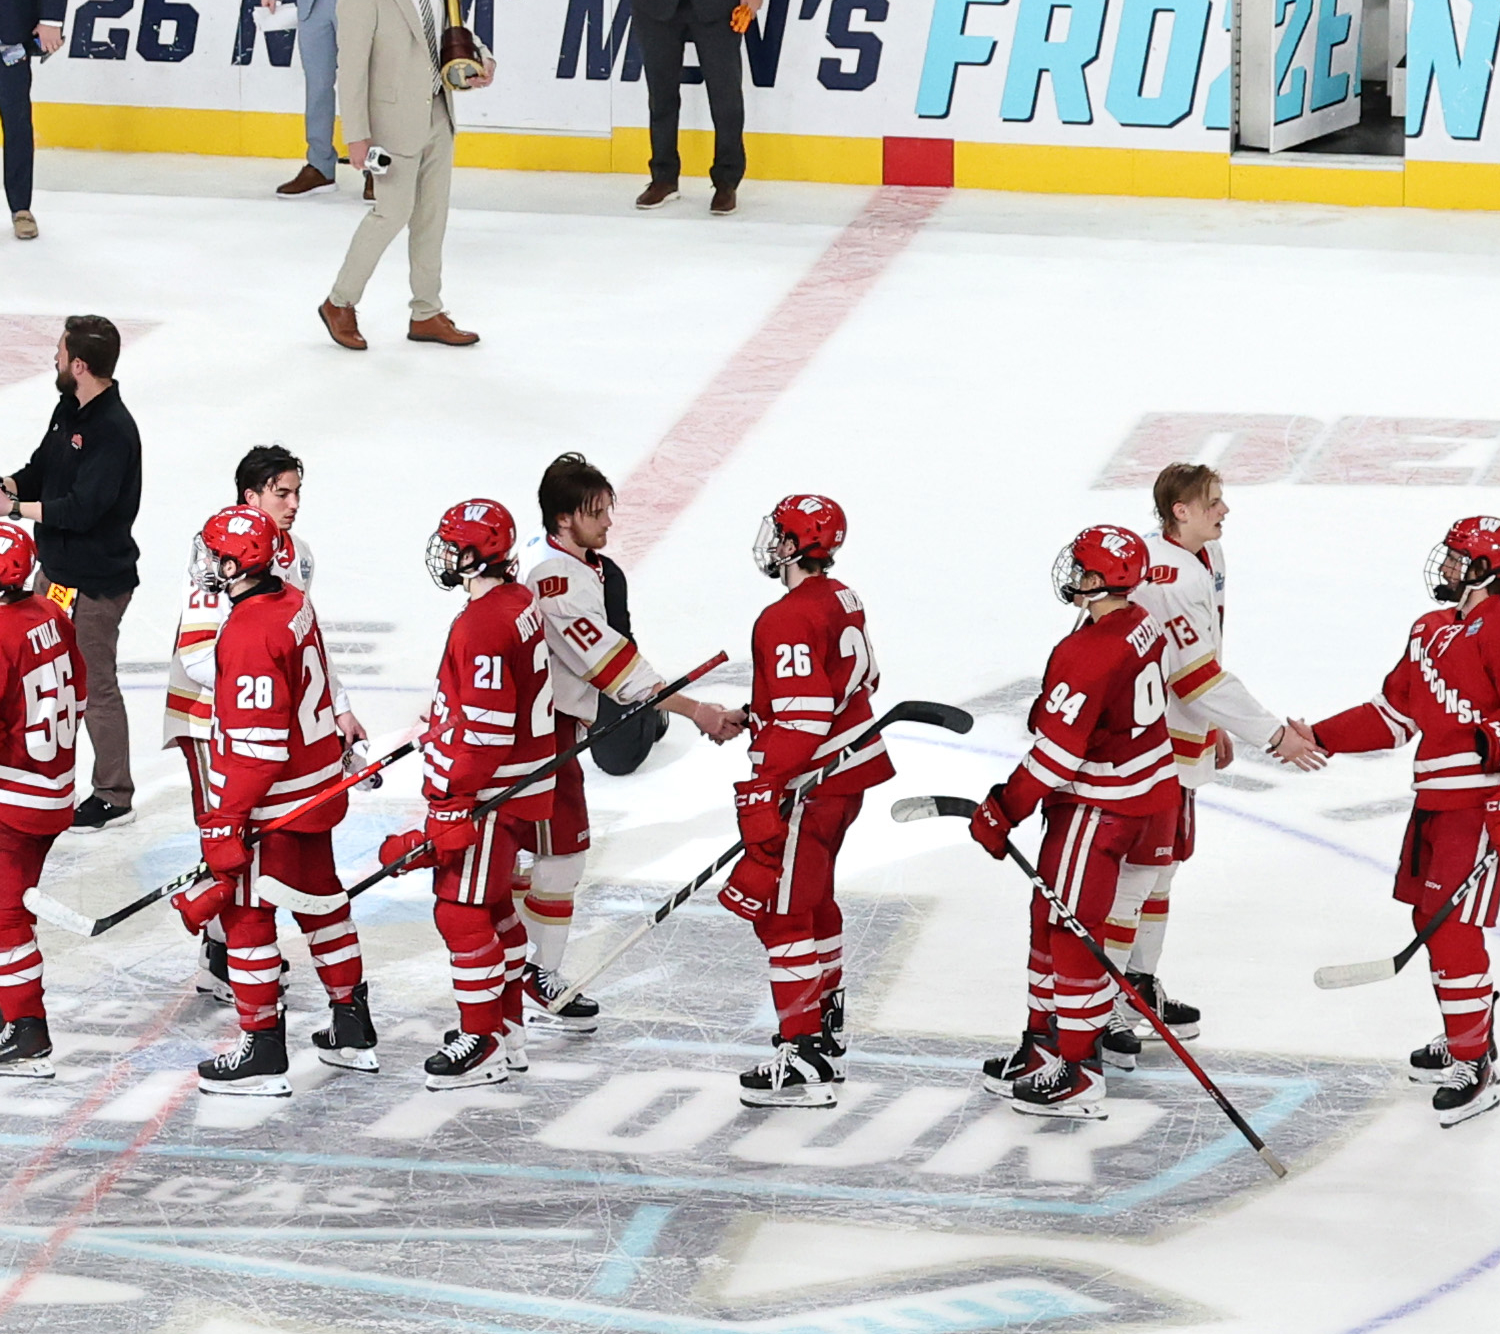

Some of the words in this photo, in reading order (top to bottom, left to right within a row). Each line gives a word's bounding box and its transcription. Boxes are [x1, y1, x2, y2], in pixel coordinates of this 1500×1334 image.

[463, 504, 488, 522] W
[796, 497, 822, 515] W
[227, 517, 254, 535] W
[1100, 533, 1128, 551] W
[561, 617, 602, 653] 19
[1165, 614, 1199, 652] 13
[473, 655, 502, 690] 21
[775, 643, 811, 678] 26
[22, 649, 78, 763] 55
[236, 675, 273, 709] 28
[1045, 682, 1088, 726] 94
[365, 1069, 1167, 1183] FOUR
